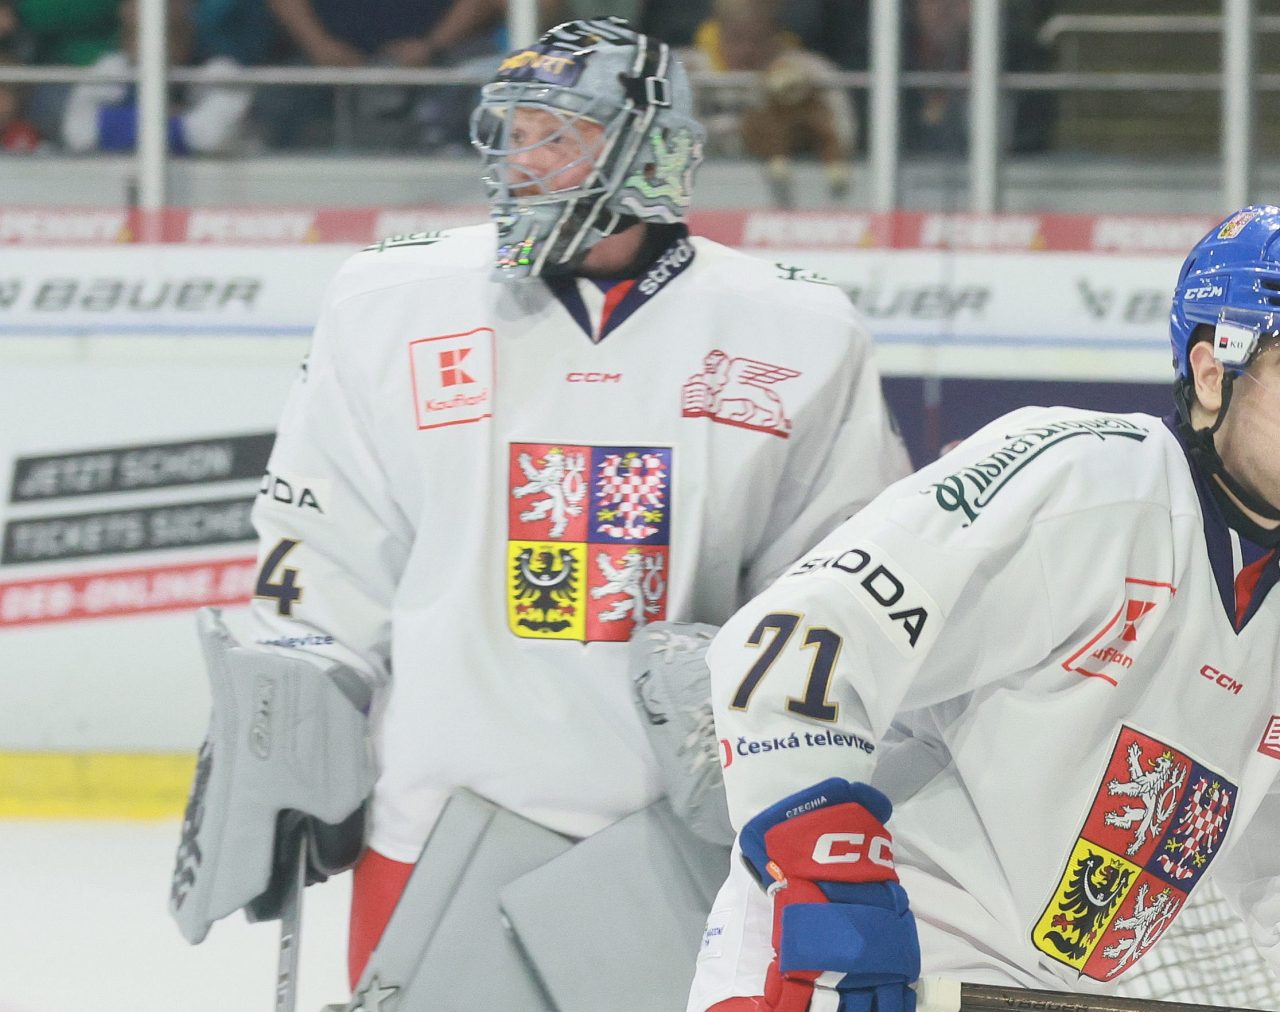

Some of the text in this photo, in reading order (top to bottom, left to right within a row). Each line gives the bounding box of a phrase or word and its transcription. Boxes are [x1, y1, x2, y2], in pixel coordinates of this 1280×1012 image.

[32, 277, 262, 313] BAUER
[1184, 284, 1223, 300] CCM
[565, 371, 622, 383] CCM
[149, 504, 254, 543] SICHE
[256, 538, 303, 616] 4
[729, 610, 844, 722] 71
[1200, 664, 1244, 695] CCM
[736, 730, 875, 756] Česká televize
[786, 796, 828, 819] CZECHIA
[811, 833, 894, 870] CC
